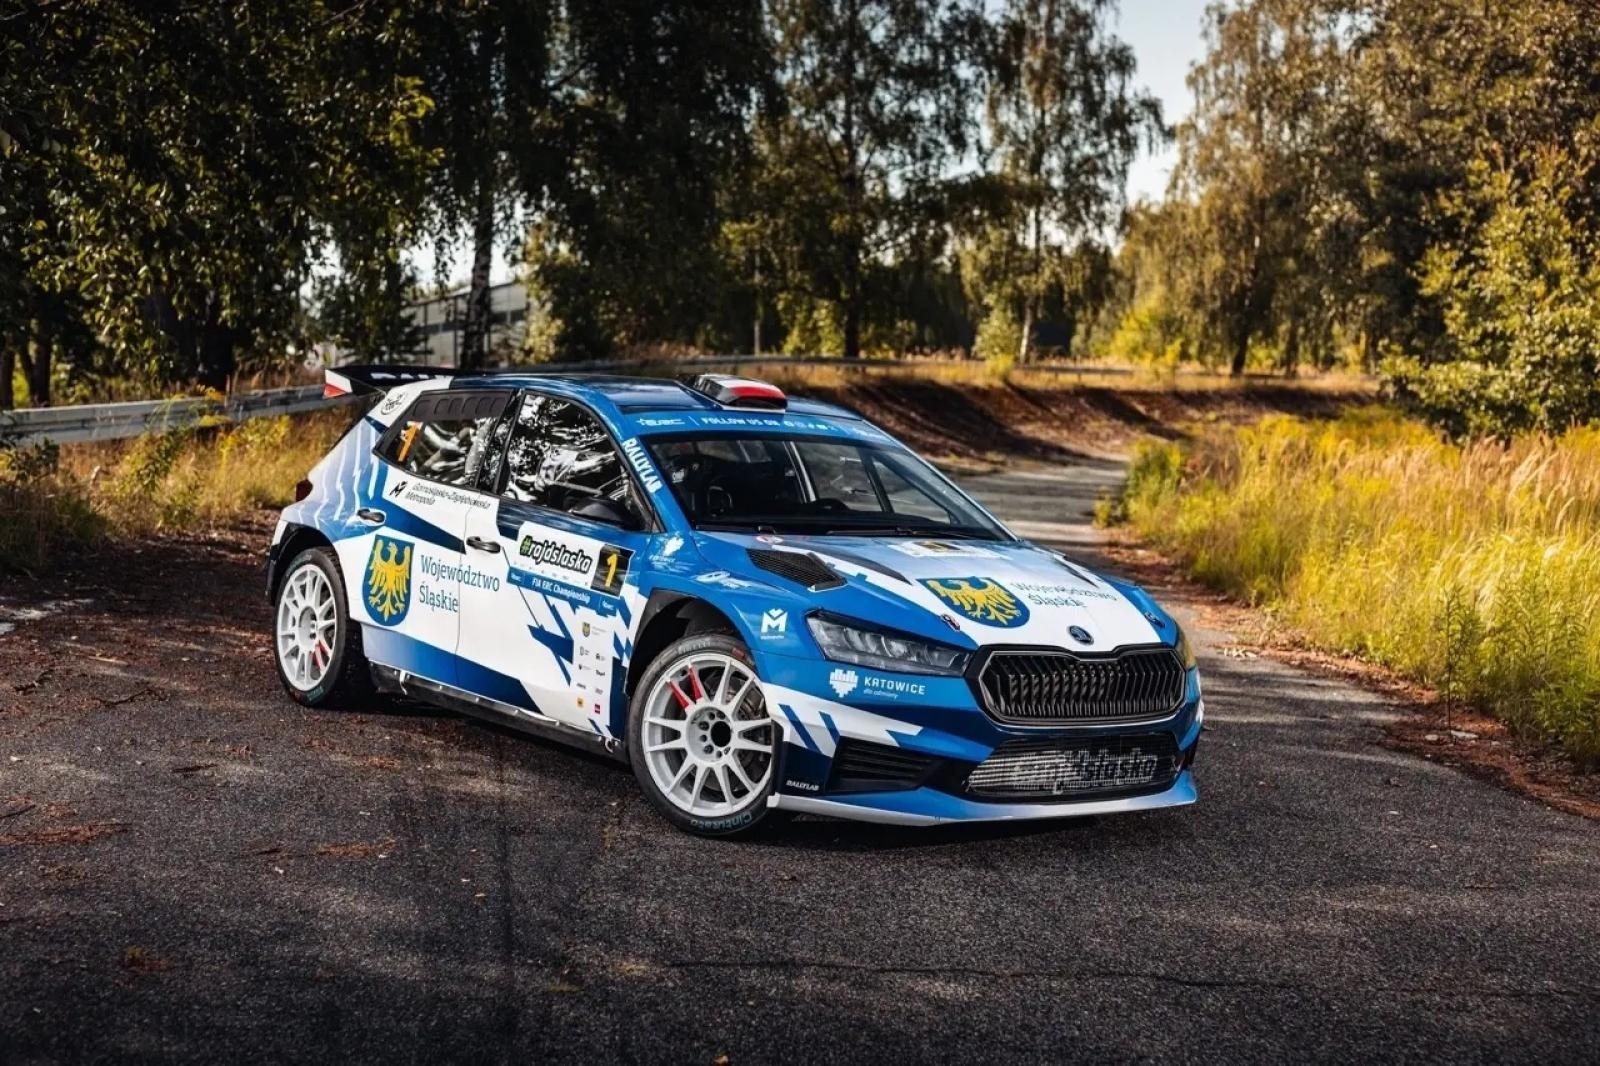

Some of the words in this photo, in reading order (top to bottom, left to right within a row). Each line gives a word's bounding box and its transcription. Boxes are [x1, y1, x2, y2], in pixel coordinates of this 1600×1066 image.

[621, 437, 663, 493] RALLYLAB
[519, 534, 593, 574] #rajdslaska
[607, 553, 619, 588] 1
[421, 554, 500, 592] Województwo
[419, 580, 459, 613] Śląskie
[553, 582, 591, 605] Championship
[863, 676, 926, 695] KATOWICE
[786, 779, 820, 791] RALLYLAB
